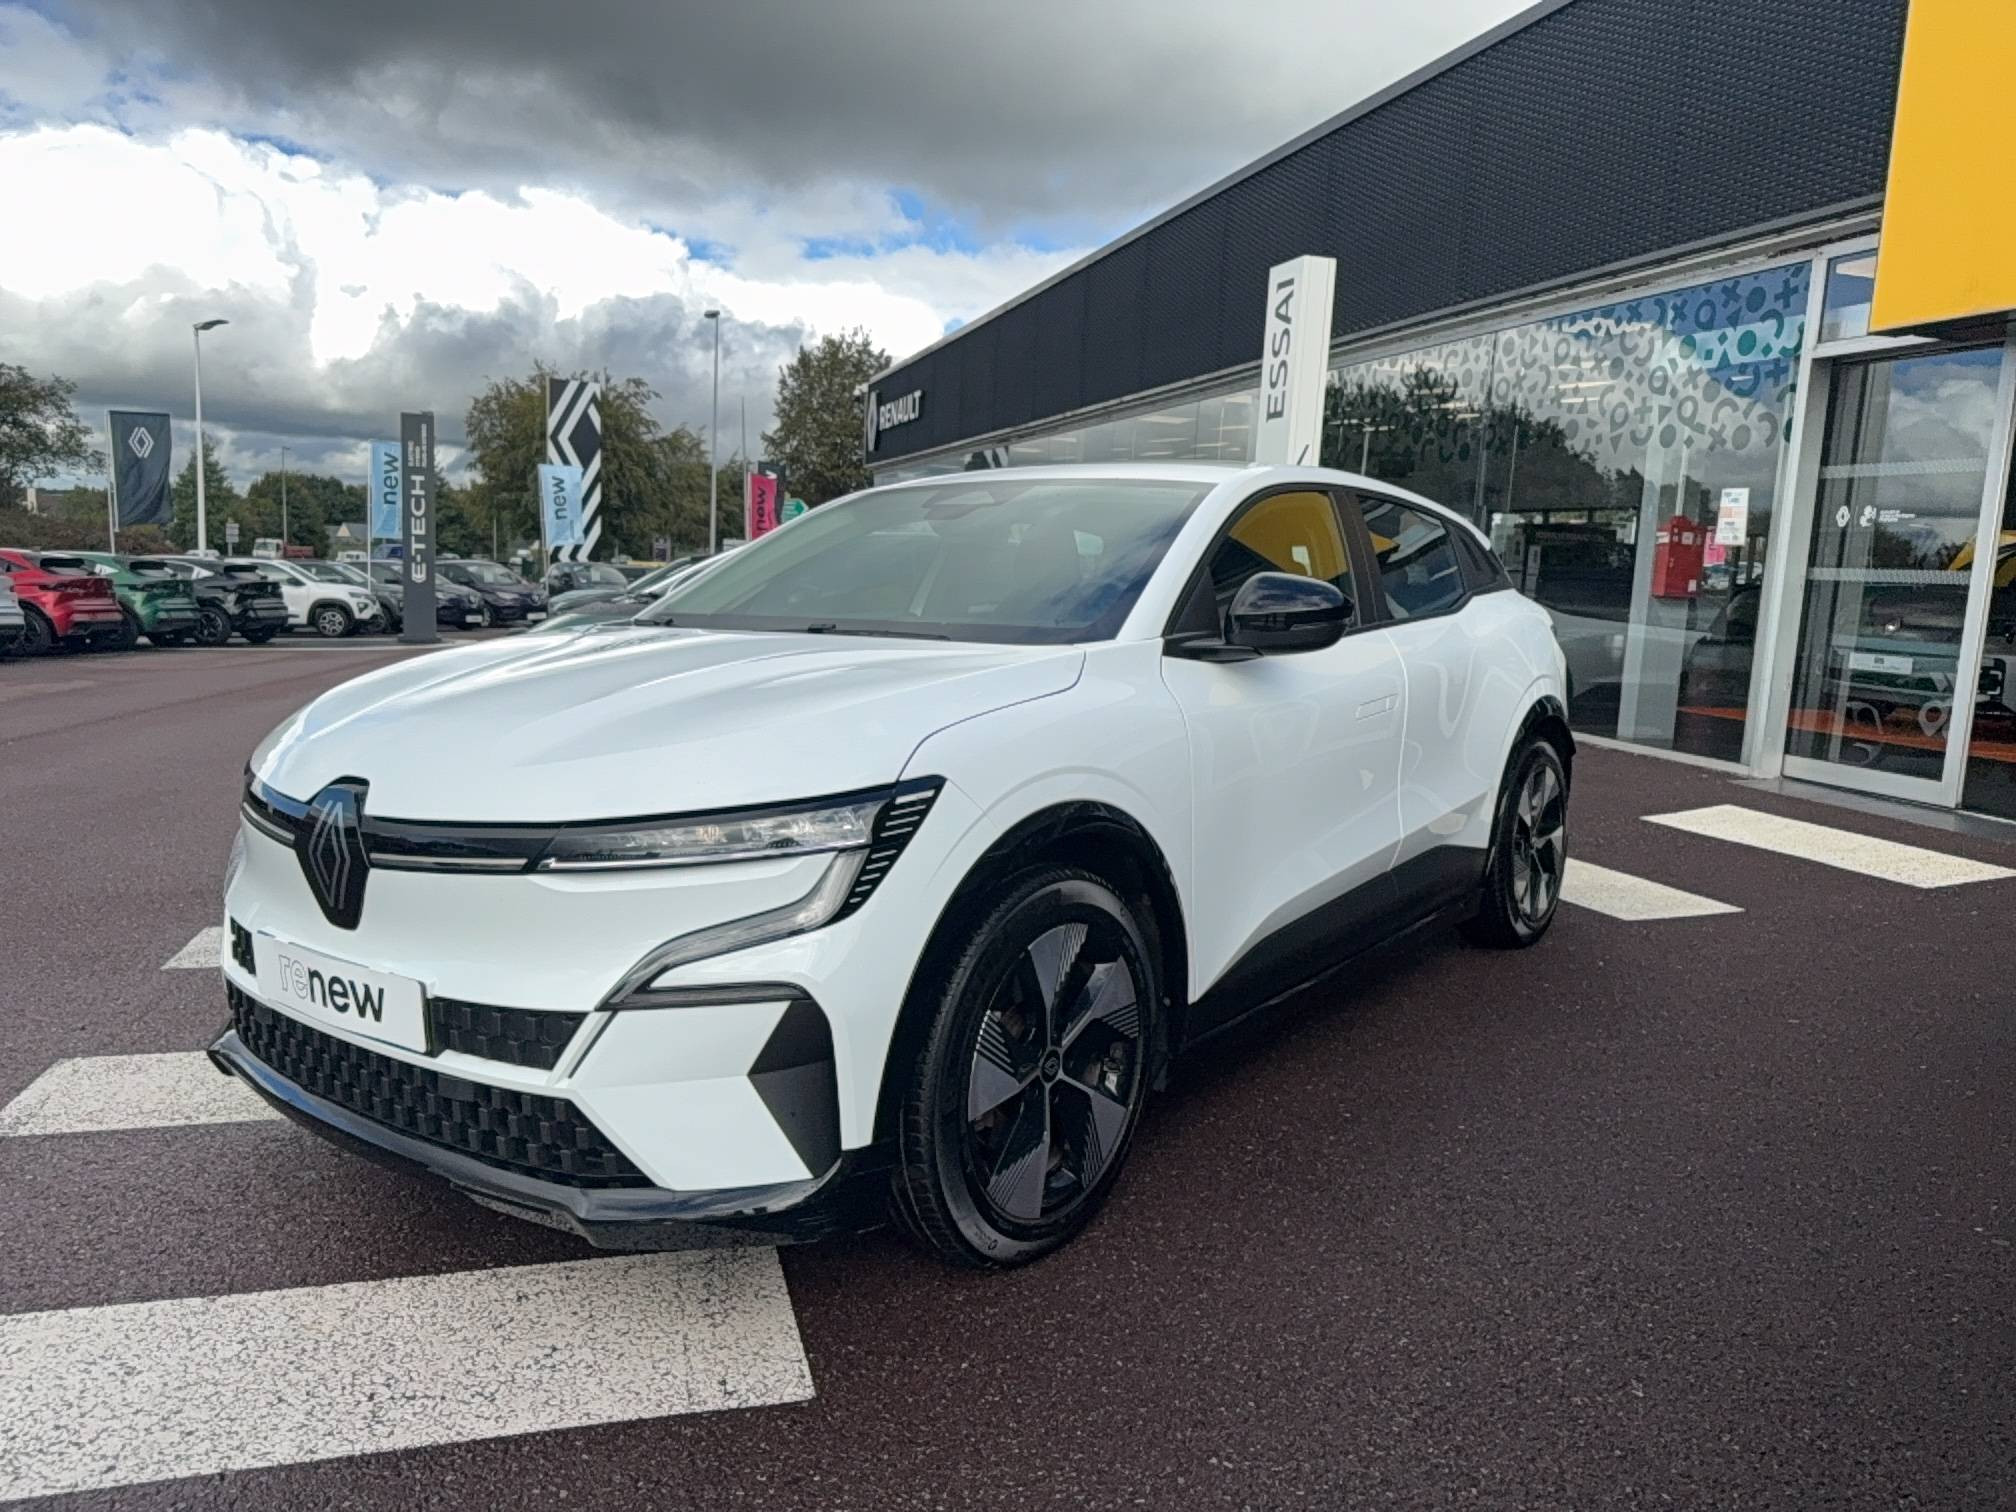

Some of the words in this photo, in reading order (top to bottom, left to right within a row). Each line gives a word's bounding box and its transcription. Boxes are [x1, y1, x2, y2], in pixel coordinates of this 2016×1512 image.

[1265, 277, 1295, 423] ESSAI
[879, 389, 922, 431] RENAULT
[383, 452, 399, 505] new
[552, 475, 568, 520] new
[410, 475, 427, 583] E-TECH
[278, 954, 384, 1023] renew
